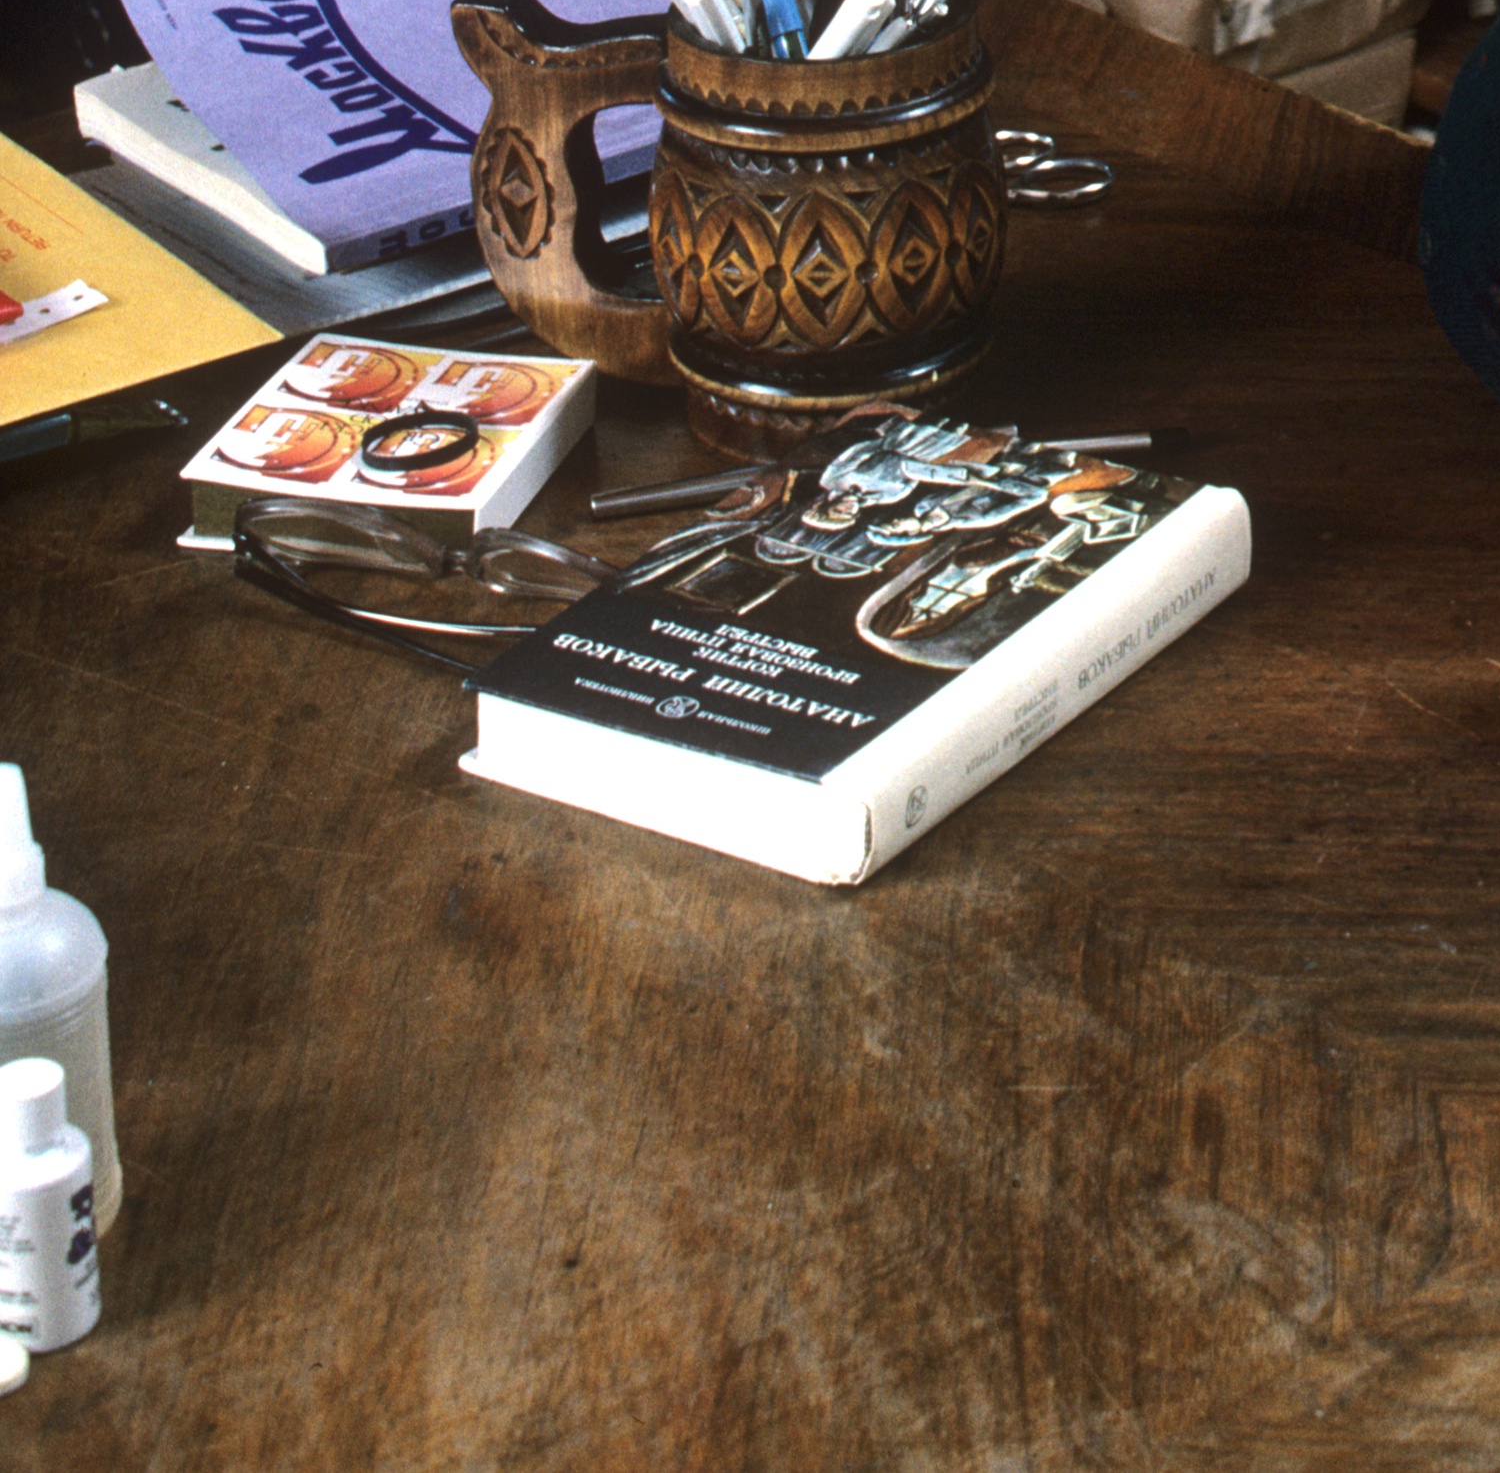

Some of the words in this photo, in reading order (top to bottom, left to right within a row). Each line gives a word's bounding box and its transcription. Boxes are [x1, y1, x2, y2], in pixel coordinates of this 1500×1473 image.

[649, 618, 727, 652] ПТИЦА
[714, 622, 820, 661] ВЫСТРЕЛ
[553, 632, 698, 683] РЫБАКОВ
[691, 648, 785, 679] КОРТИК
[728, 640, 862, 686] БРОНЗОВАЯ
